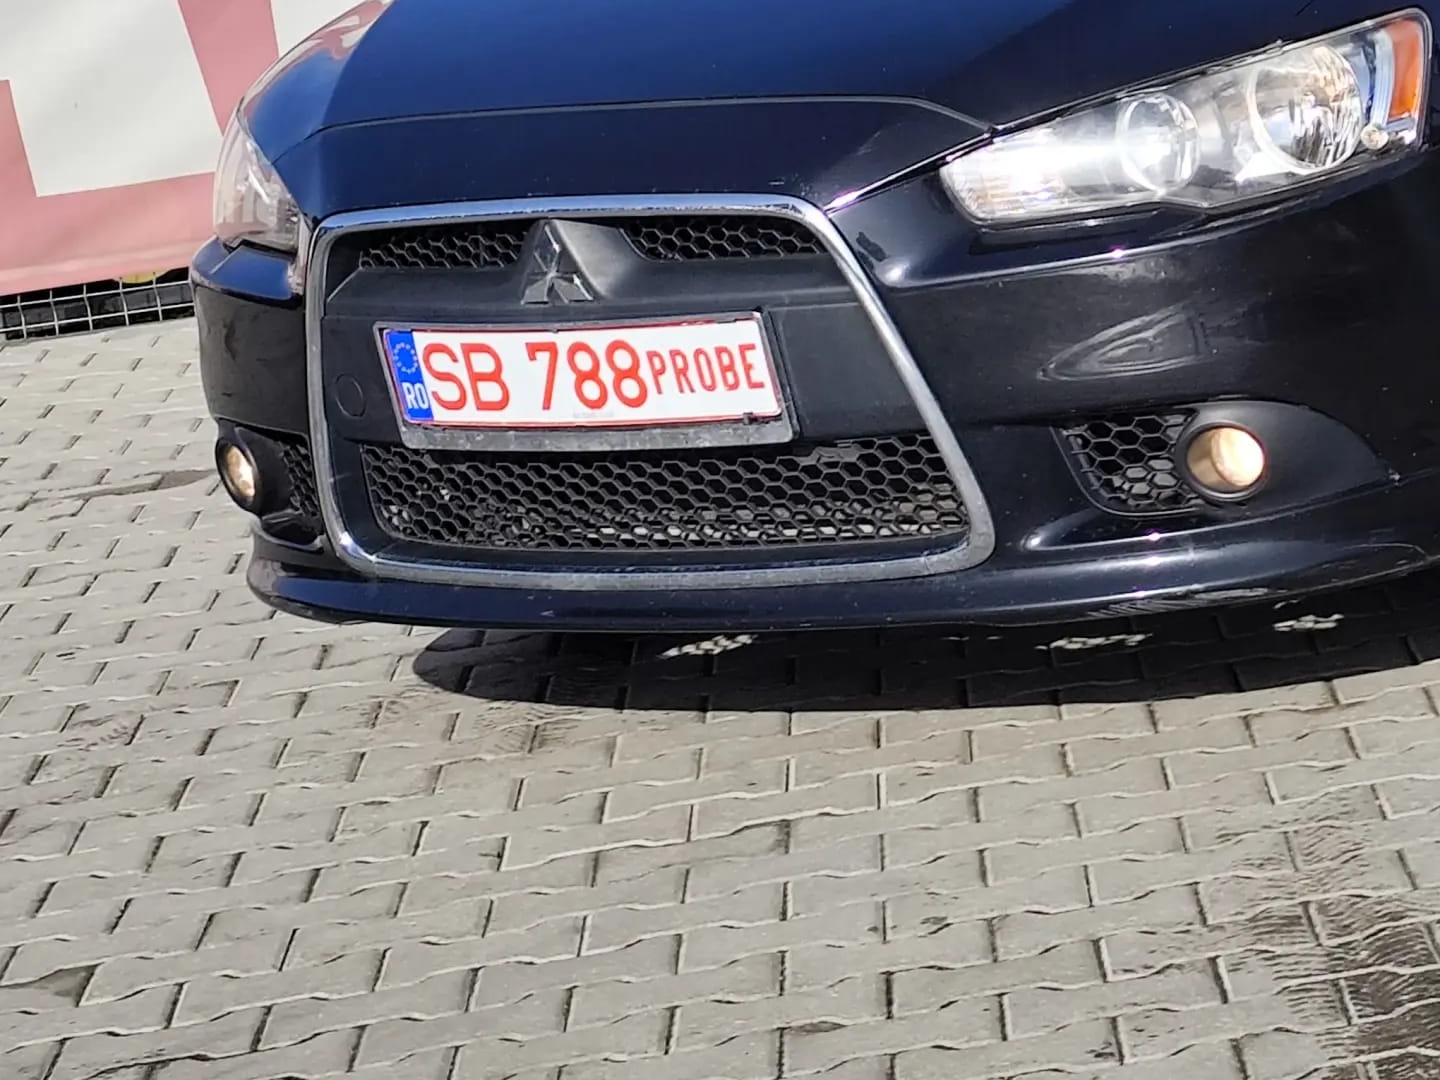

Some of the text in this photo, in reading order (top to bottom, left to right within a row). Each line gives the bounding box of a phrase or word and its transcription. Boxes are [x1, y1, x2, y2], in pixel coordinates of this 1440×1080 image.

[406, 382, 429, 410] RO
[422, 339, 765, 411] SB 788 PROBE
